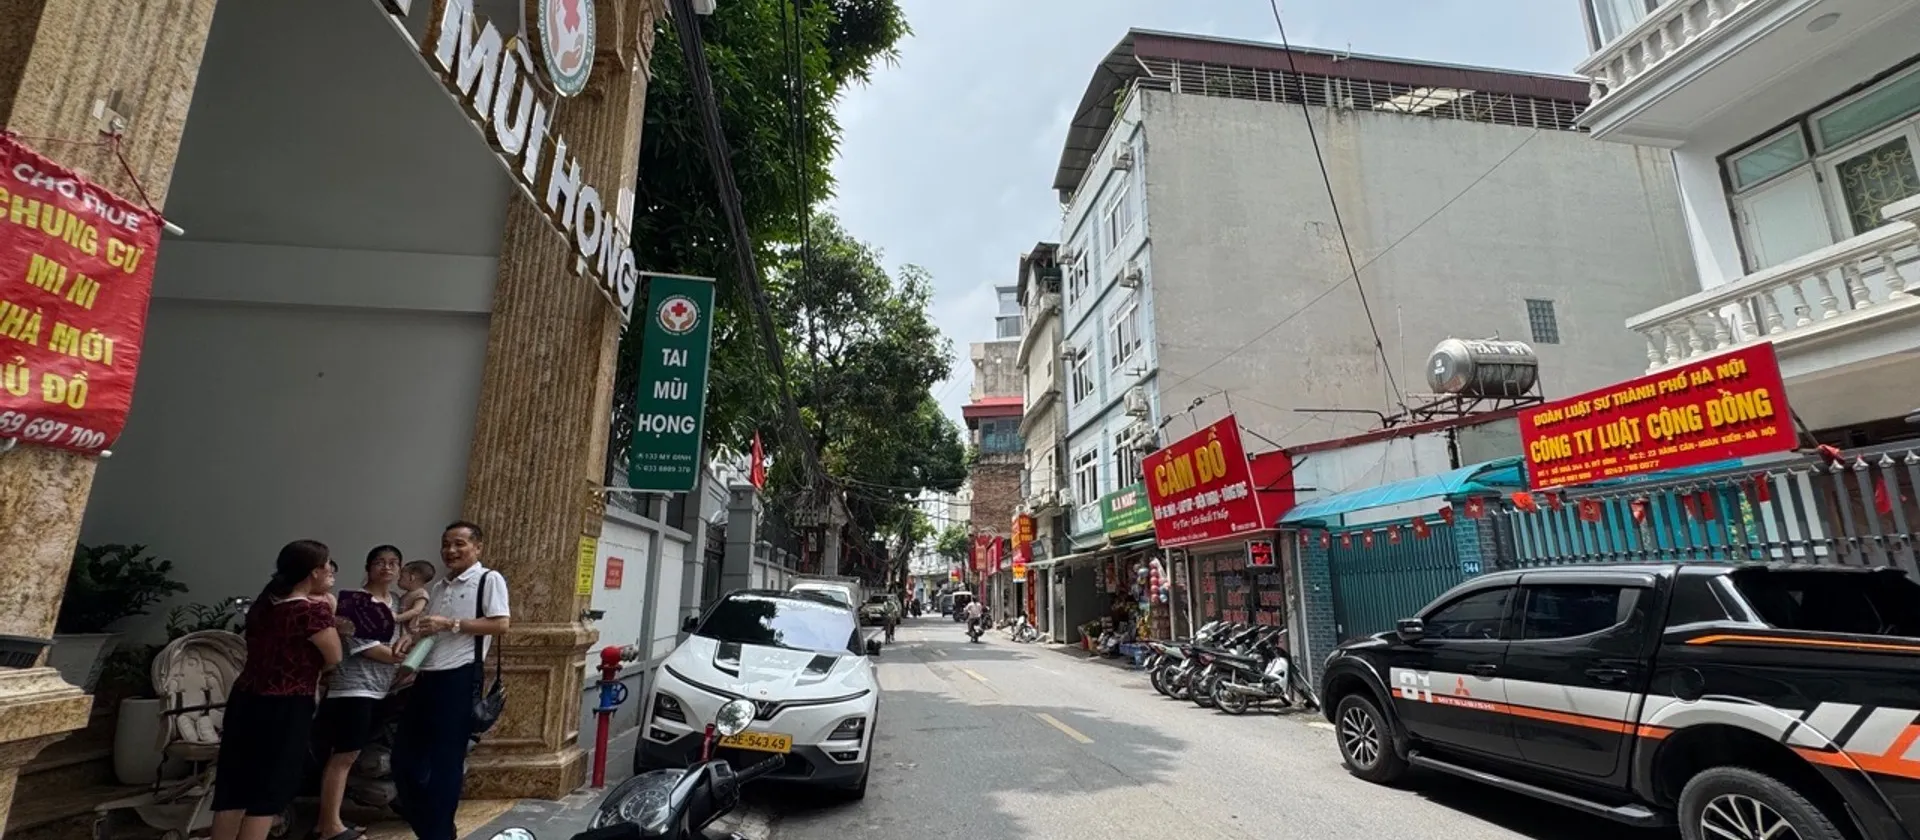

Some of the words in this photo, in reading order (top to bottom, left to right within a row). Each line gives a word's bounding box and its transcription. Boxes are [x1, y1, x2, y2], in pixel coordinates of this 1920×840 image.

[12, 163, 77, 199] CHO
[82, 192, 141, 233] THUÊ
[546, 134, 638, 307] HỌNG
[106, 237, 145, 274] CƯ
[26, 253, 68, 296] MI
[66, 272, 101, 311] NI
[48, 321, 114, 367] MỚI
[661, 348, 687, 367] TAI
[0, 355, 30, 397] Ủ
[653, 377, 687, 400] MŨI
[1533, 408, 1563, 427] ĐOÀN
[1565, 400, 1592, 418] LUẬT
[1593, 394, 1611, 411] SƯ
[1612, 383, 1657, 406] THÀNH
[1658, 370, 1688, 394] PHỐ
[1690, 366, 1715, 386] HÀ
[1716, 358, 1747, 380] NỘI
[24, 417, 69, 442] 697
[67, 426, 106, 449] 700
[638, 414, 696, 438] HỌNG
[1530, 434, 1572, 463] CÔNG
[1573, 428, 1594, 454] TY
[1597, 416, 1641, 449] LUẬT
[1646, 404, 1704, 440] CỘNG
[1705, 388, 1774, 427] ĐỒNG
[1154, 448, 1197, 497] CẦM
[1195, 426, 1227, 484] ĐỒ
